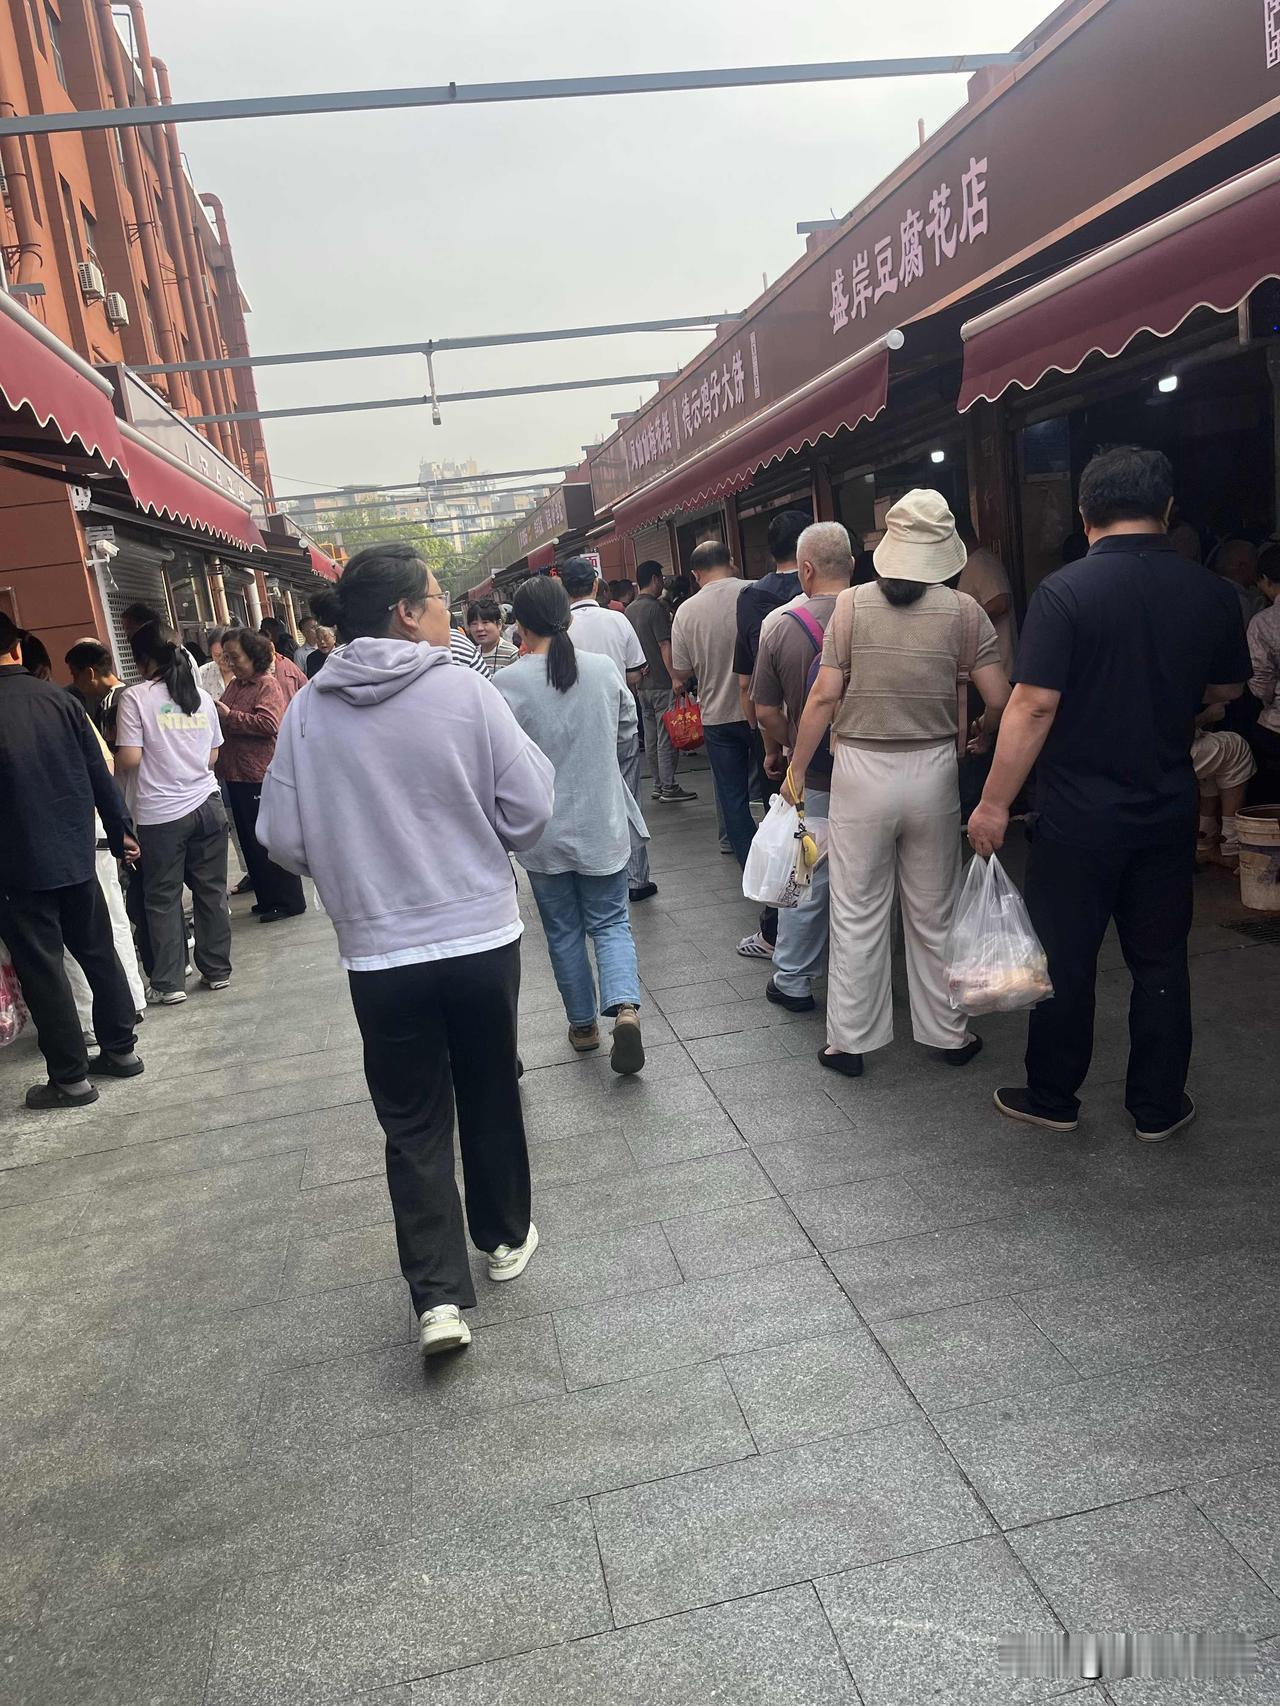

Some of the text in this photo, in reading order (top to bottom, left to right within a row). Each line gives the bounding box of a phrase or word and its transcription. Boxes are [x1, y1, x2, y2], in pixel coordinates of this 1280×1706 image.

[829, 156, 990, 335] 盛岸豆腐花店
